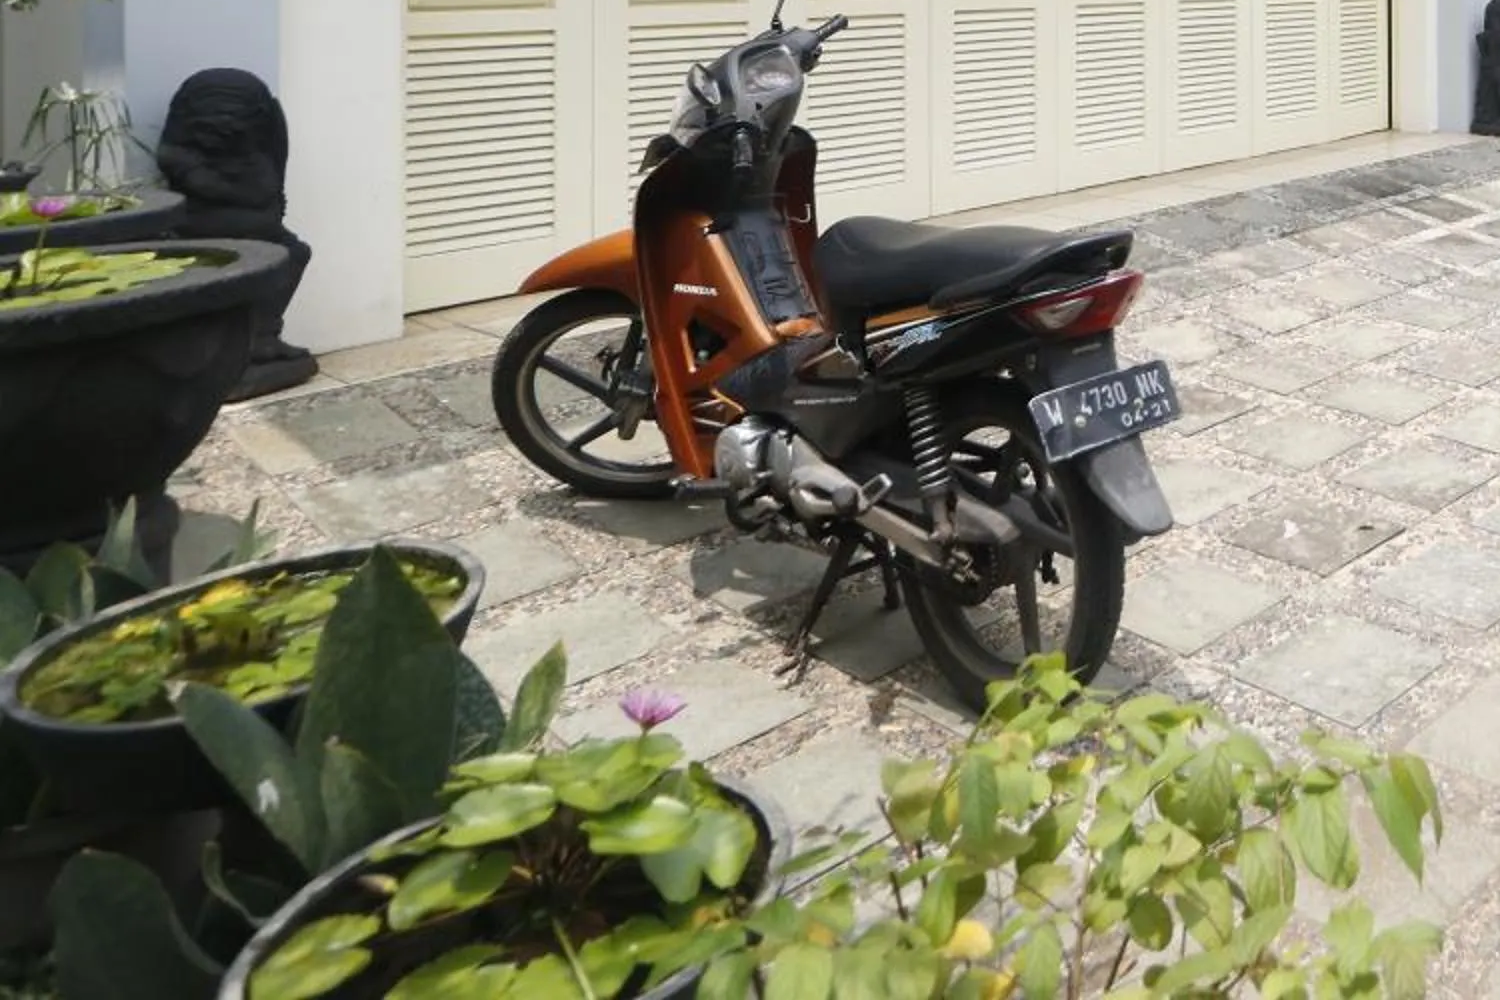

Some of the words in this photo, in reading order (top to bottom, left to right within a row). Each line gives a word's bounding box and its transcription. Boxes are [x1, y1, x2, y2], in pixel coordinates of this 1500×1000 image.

[673, 283, 718, 297] HONDA
[1042, 397, 1063, 427] W
[1079, 381, 1127, 417] 4730
